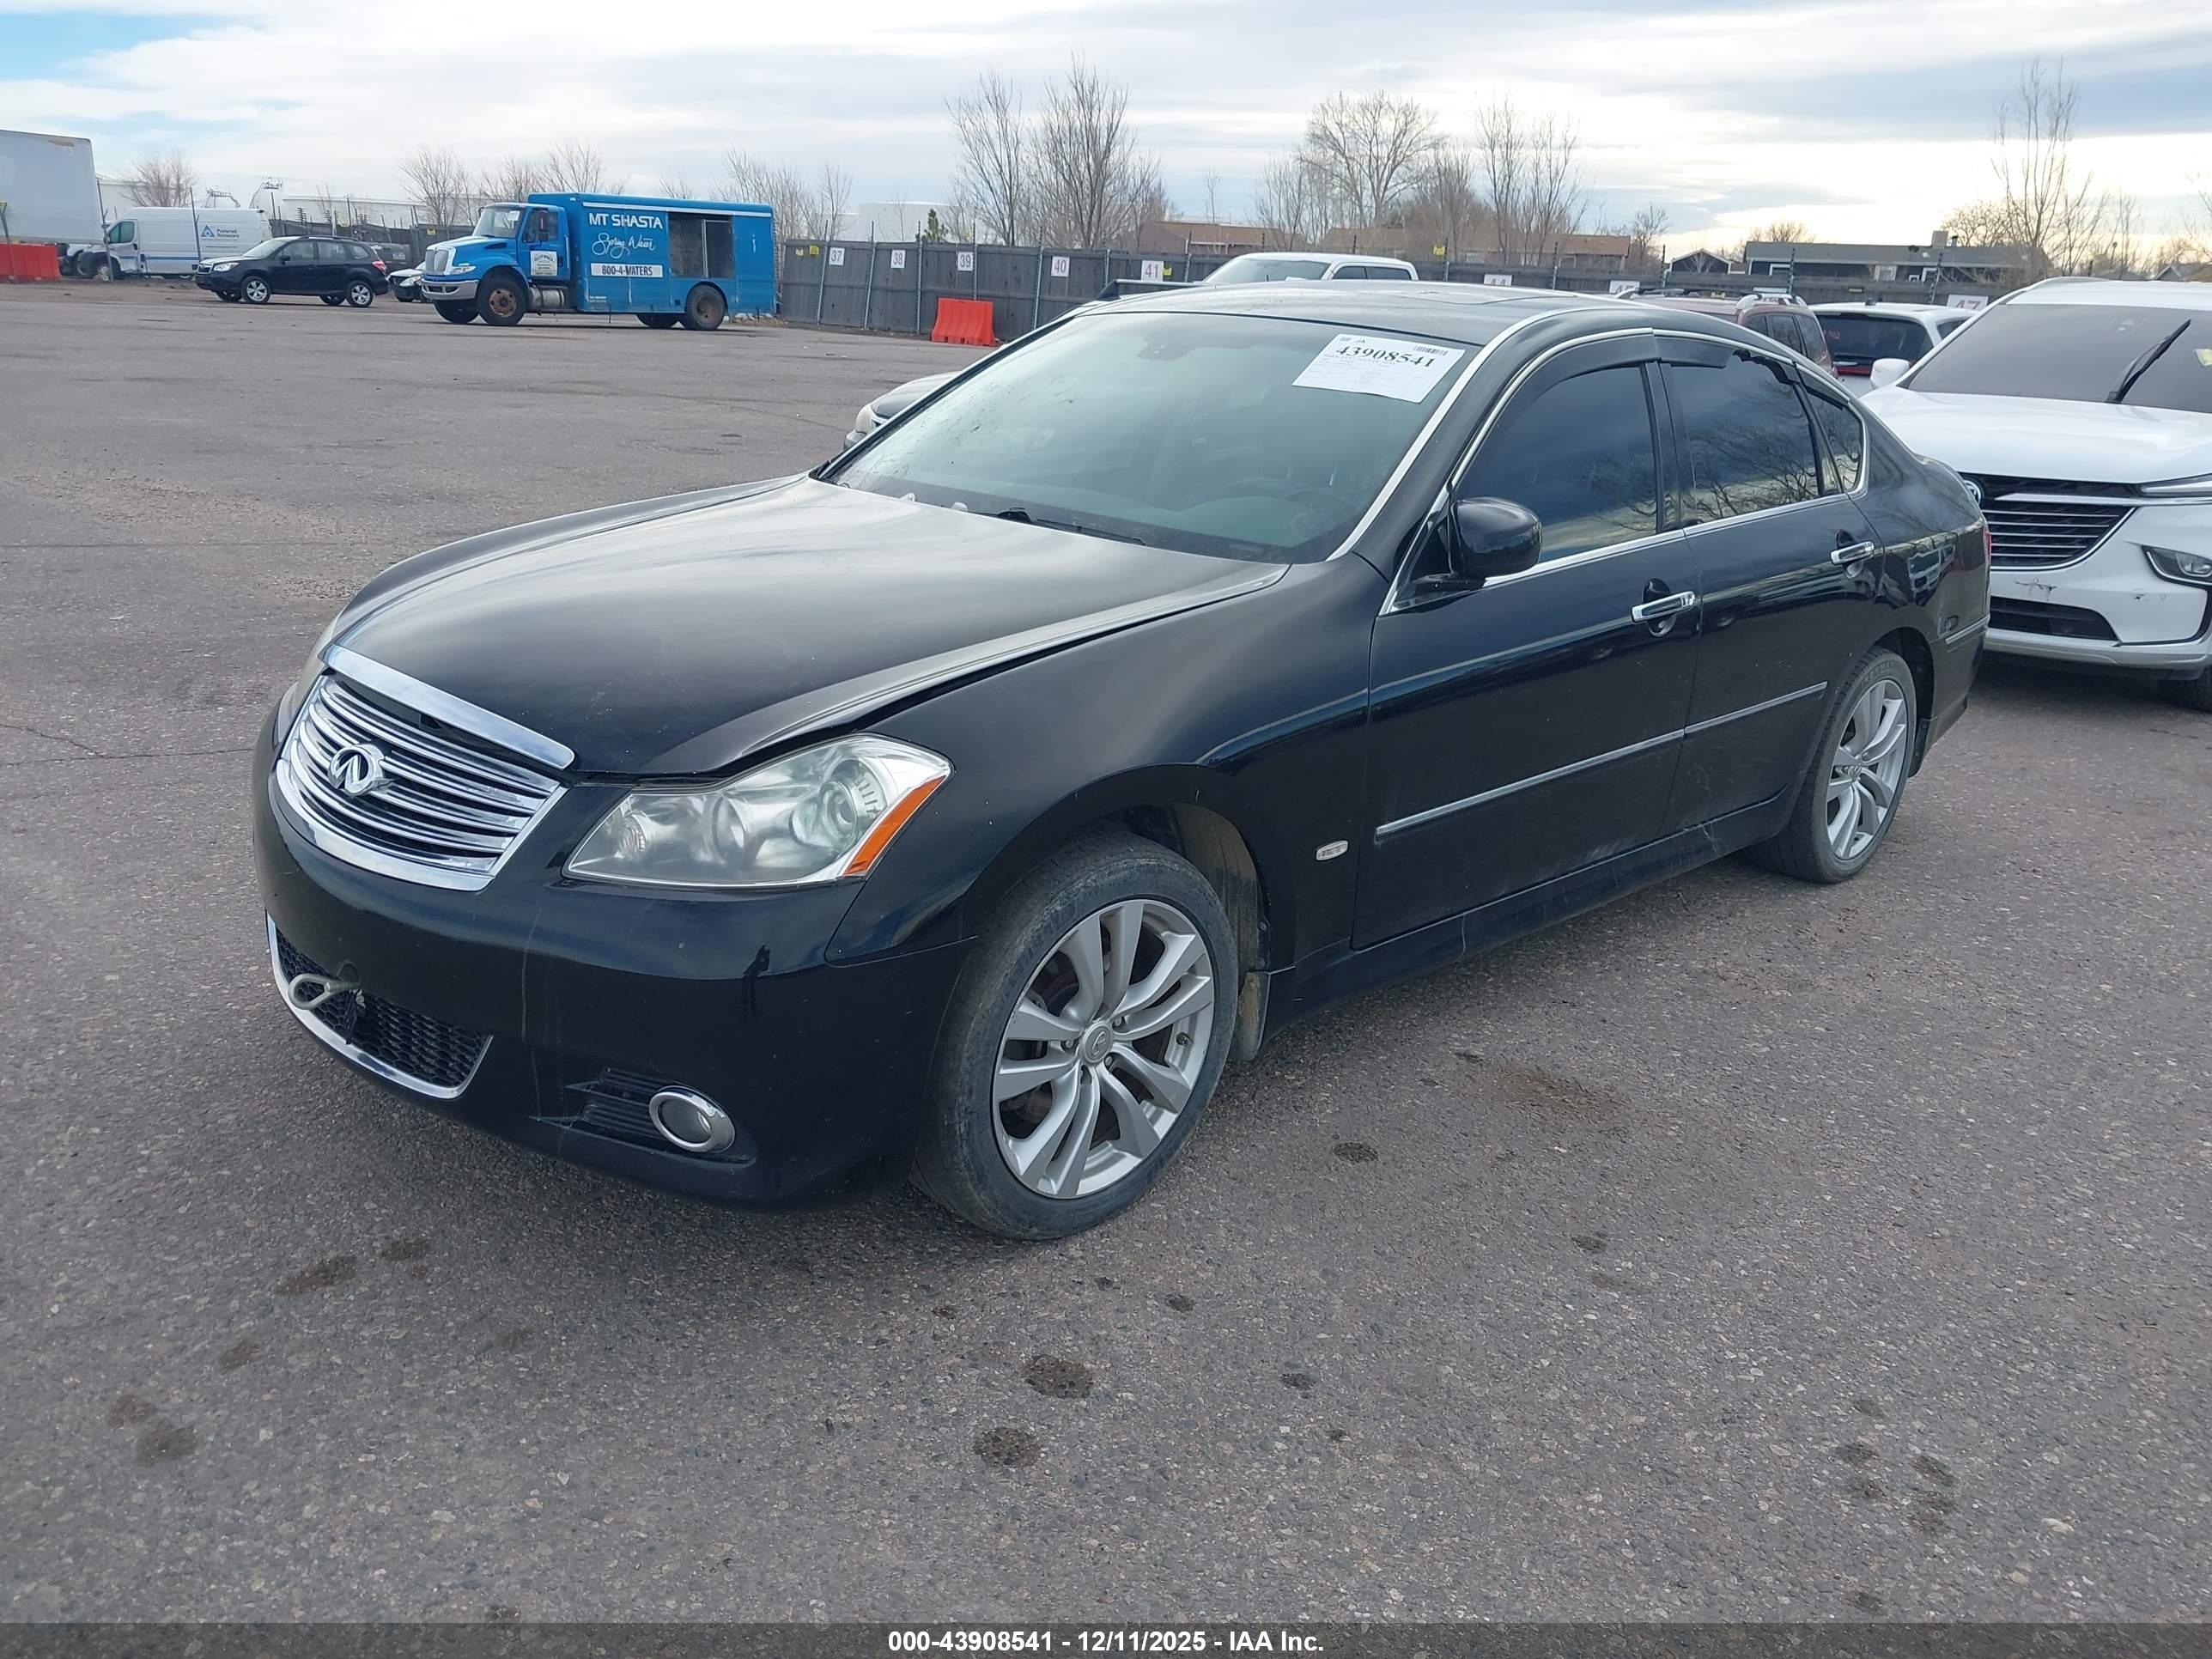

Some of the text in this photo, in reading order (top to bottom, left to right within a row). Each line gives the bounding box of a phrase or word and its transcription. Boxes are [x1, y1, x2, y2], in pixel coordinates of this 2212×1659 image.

[589, 212, 663, 229] MT SHASTA
[831, 250, 842, 262] 37
[893, 252, 903, 265] 38
[960, 254, 971, 267] 39
[1054, 259, 1067, 273] 40
[1145, 264, 1158, 278] 41
[1336, 345, 1437, 368] 43908541
